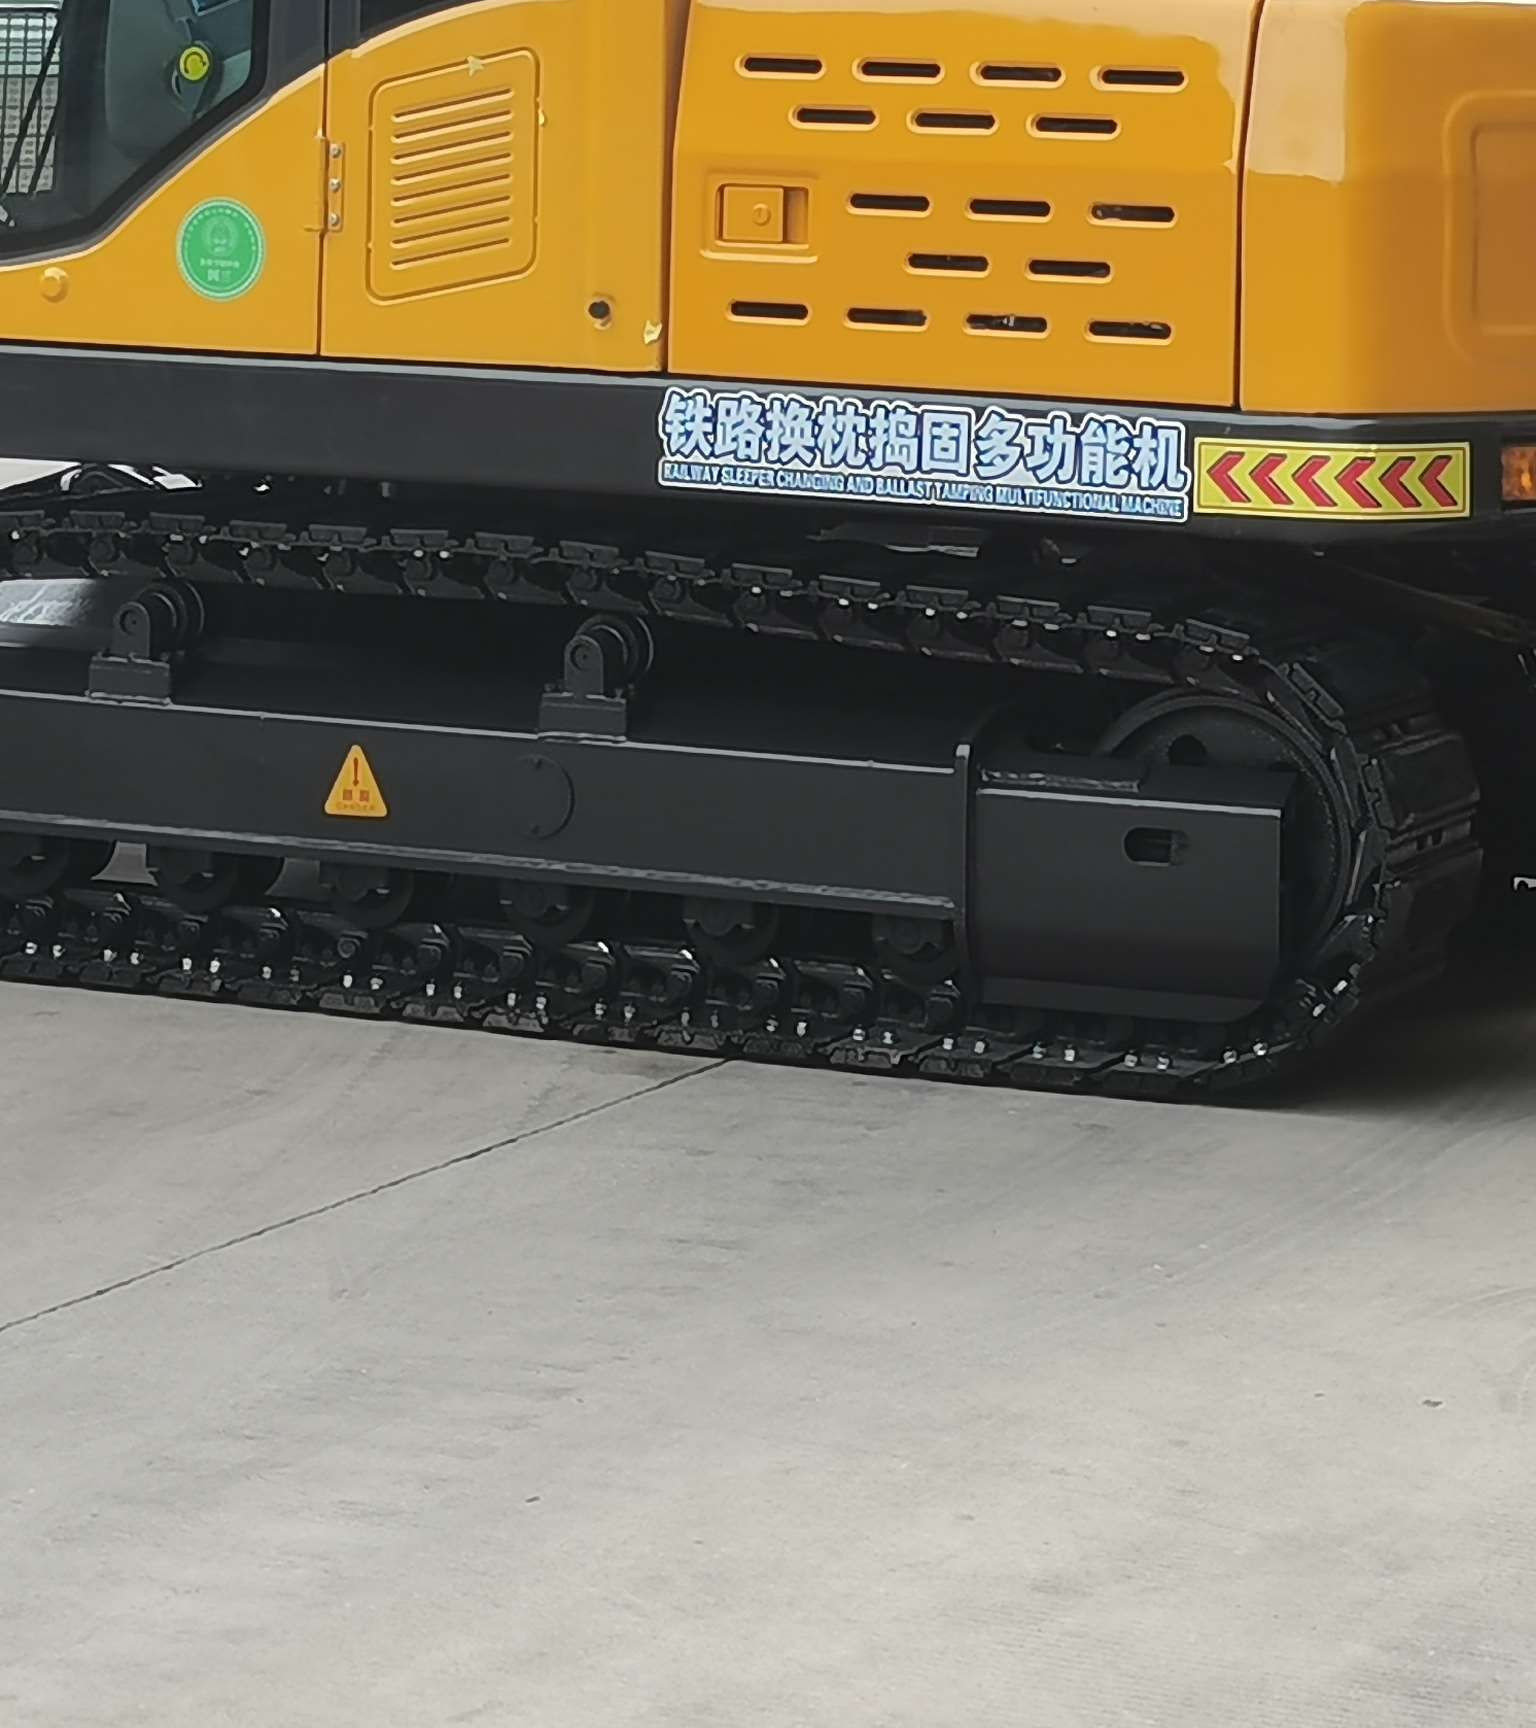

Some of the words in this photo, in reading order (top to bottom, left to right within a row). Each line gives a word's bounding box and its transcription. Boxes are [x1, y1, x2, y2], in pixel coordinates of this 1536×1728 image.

[664, 391, 1185, 490] 铁路换枕捣固多功能机
[664, 462, 721, 483] RAILWAY
[721, 467, 775, 488] SLEEPER
[776, 471, 844, 493] CHANGING
[846, 475, 874, 495] AND
[875, 477, 932, 500] BALLAST
[934, 482, 993, 503] TAMPING
[996, 486, 1119, 513] MULTIFUNCTIONAL
[1120, 496, 1183, 518] MACHINE
